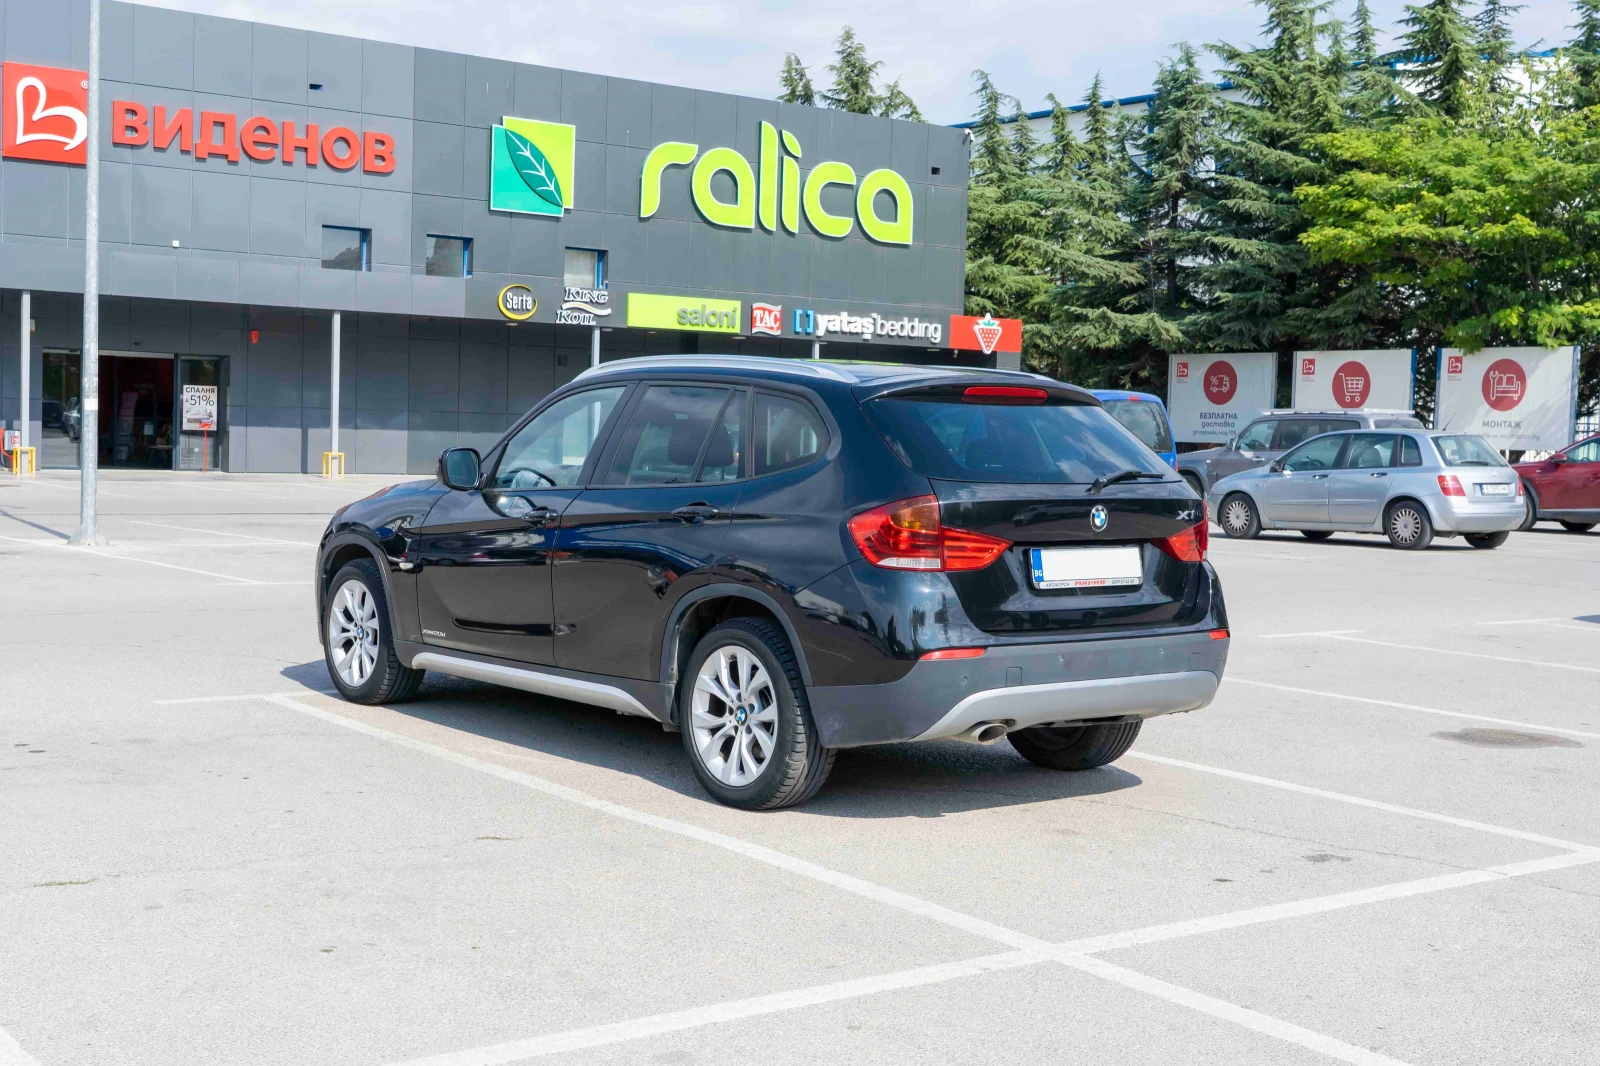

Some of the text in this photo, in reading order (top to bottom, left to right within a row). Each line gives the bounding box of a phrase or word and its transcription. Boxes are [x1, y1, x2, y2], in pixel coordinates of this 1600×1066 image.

[639, 120, 914, 246] ralica
[505, 292, 533, 312] Serta
[564, 286, 608, 304] KING
[556, 309, 596, 326] KOIL
[752, 308, 781, 332] TAÇ
[815, 311, 875, 340] yataş
[185, 395, 215, 406] -51%
[1199, 412, 1238, 420] БЕЗПЛАТНА
[1202, 421, 1235, 429] доставка
[1482, 420, 1522, 429] МОНТАЖ
[1176, 510, 1195, 520] X1
[1034, 569, 1043, 577] BG
